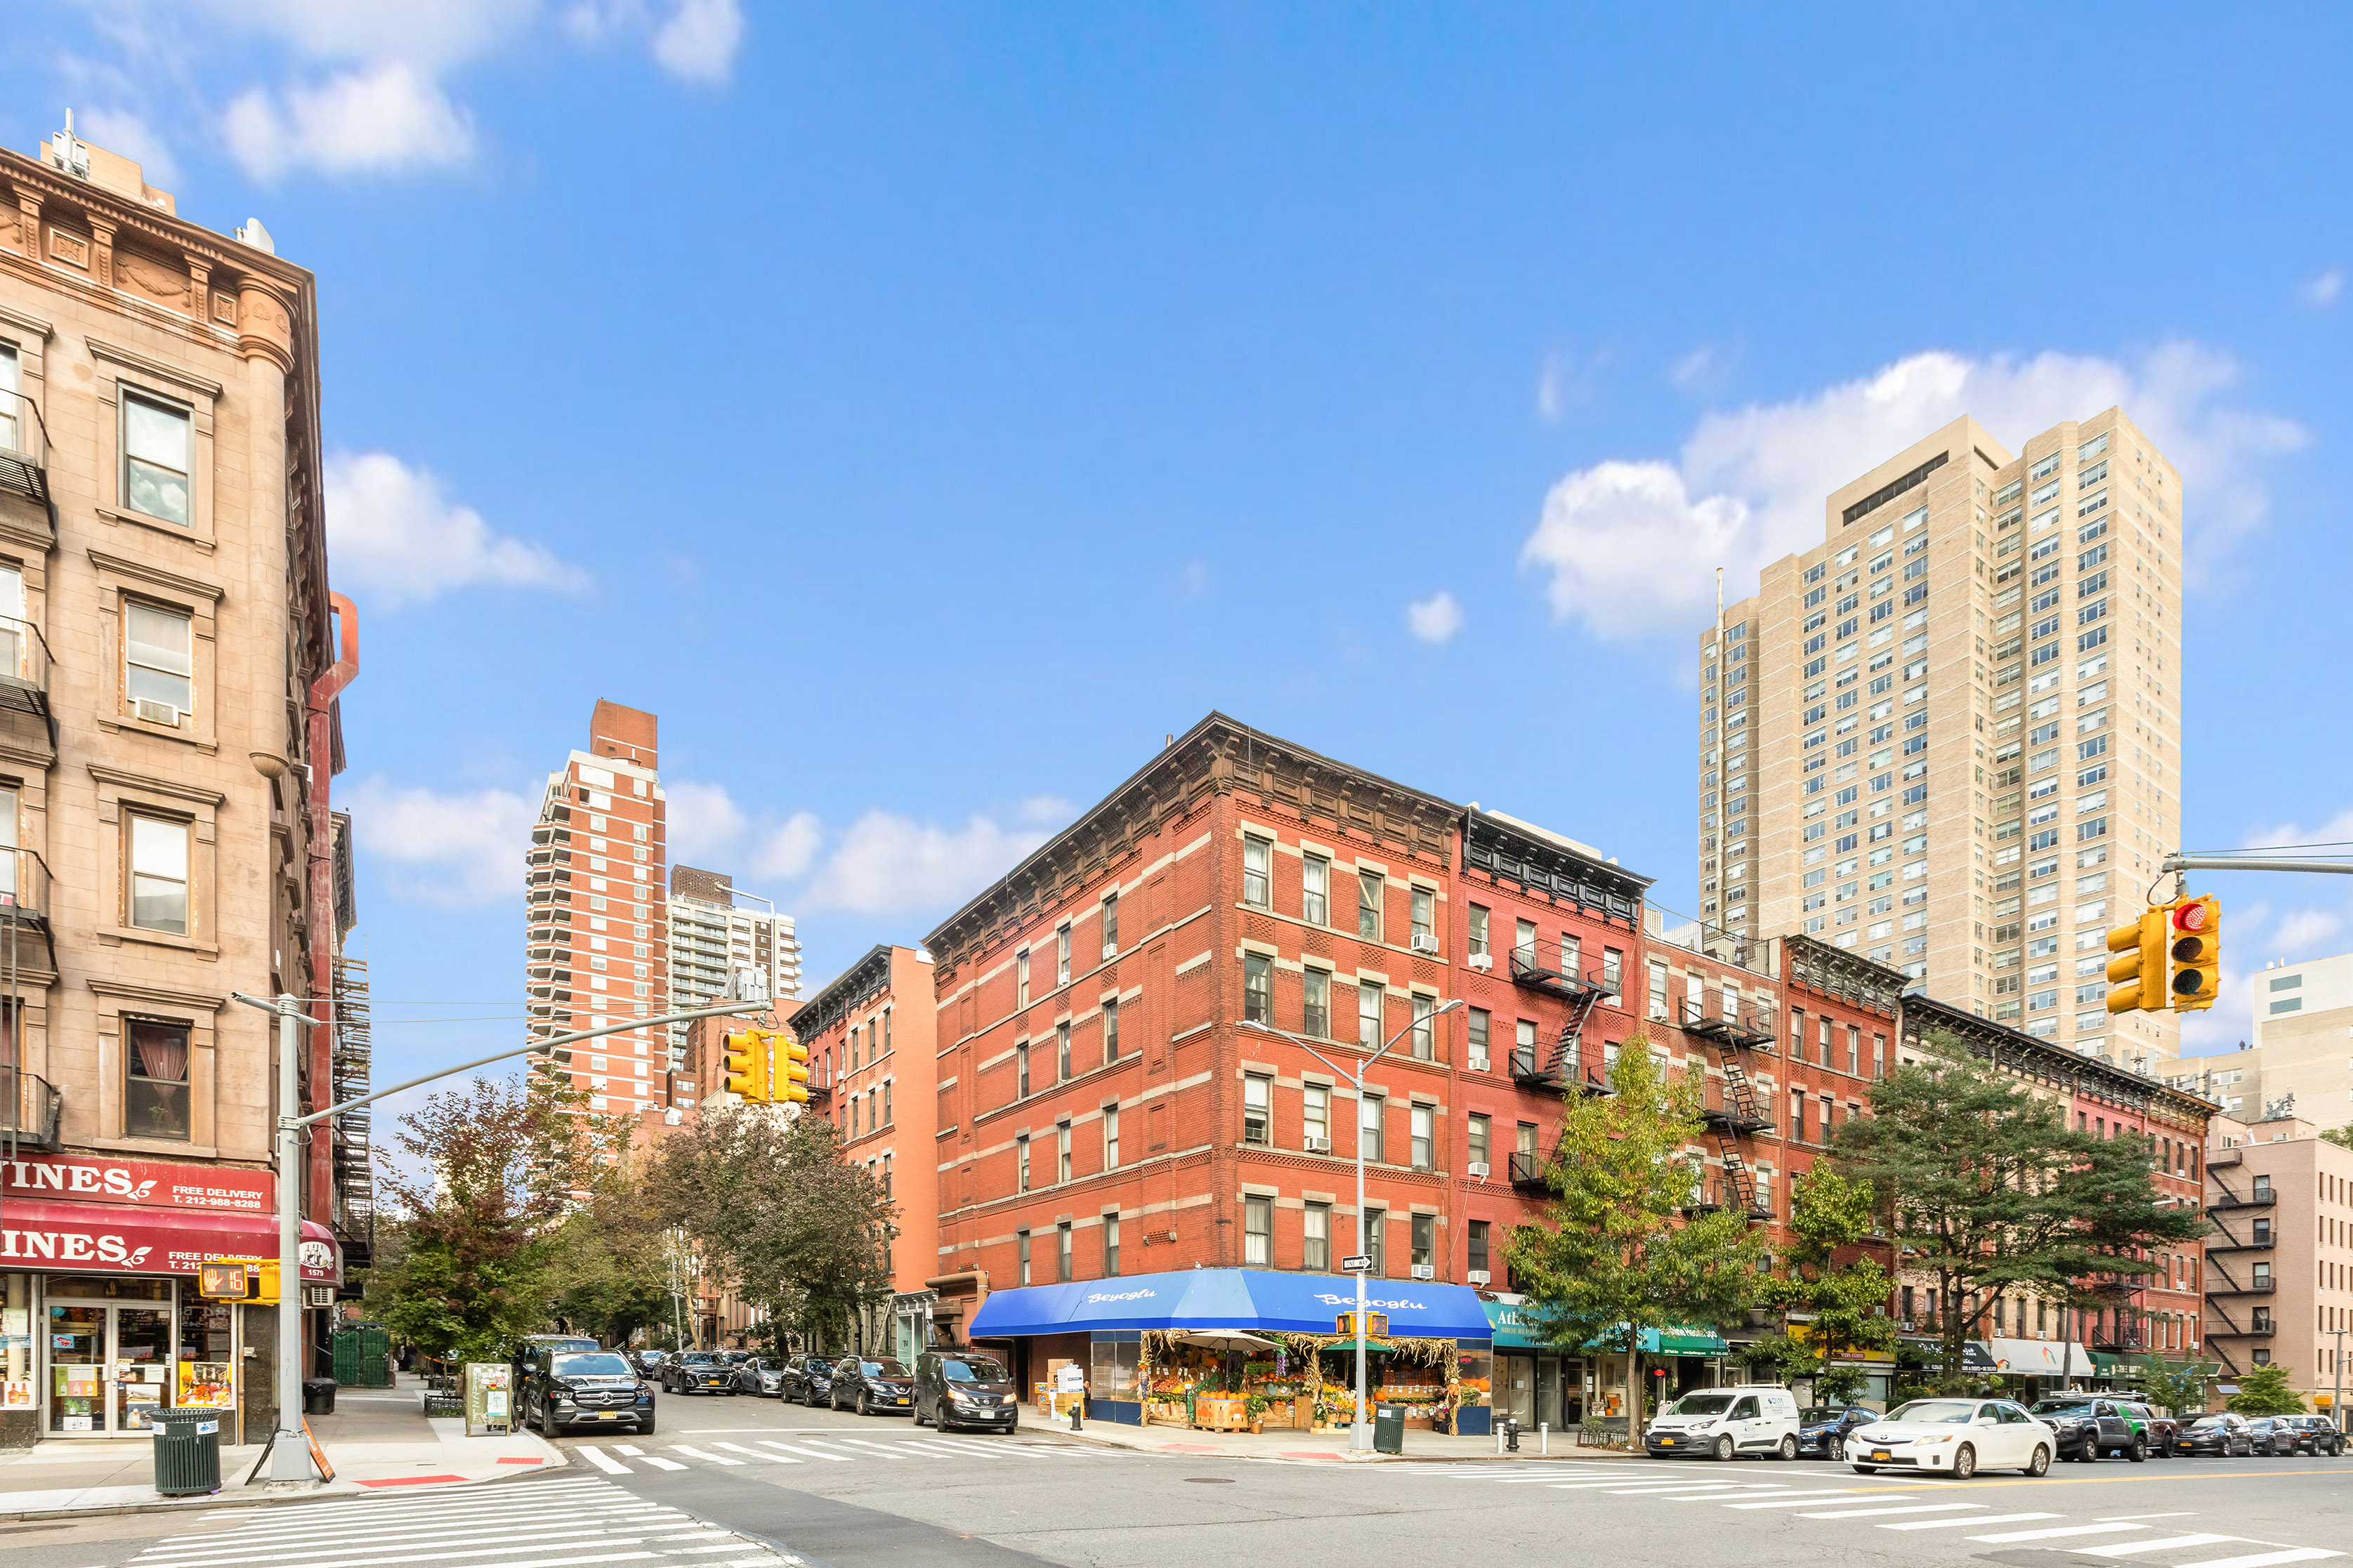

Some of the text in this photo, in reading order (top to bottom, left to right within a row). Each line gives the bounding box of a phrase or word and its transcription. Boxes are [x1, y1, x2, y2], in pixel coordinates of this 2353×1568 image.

[0, 1161, 133, 1194] INES
[172, 1185, 263, 1199] FREE DELIVERY
[185, 1196, 261, 1208] 212-988-8288
[169, 1251, 201, 1260] FREE
[168, 1260, 179, 1270] T.
[229, 1270, 244, 1291] 16
[1087, 1289, 1158, 1304] Beyoglu
